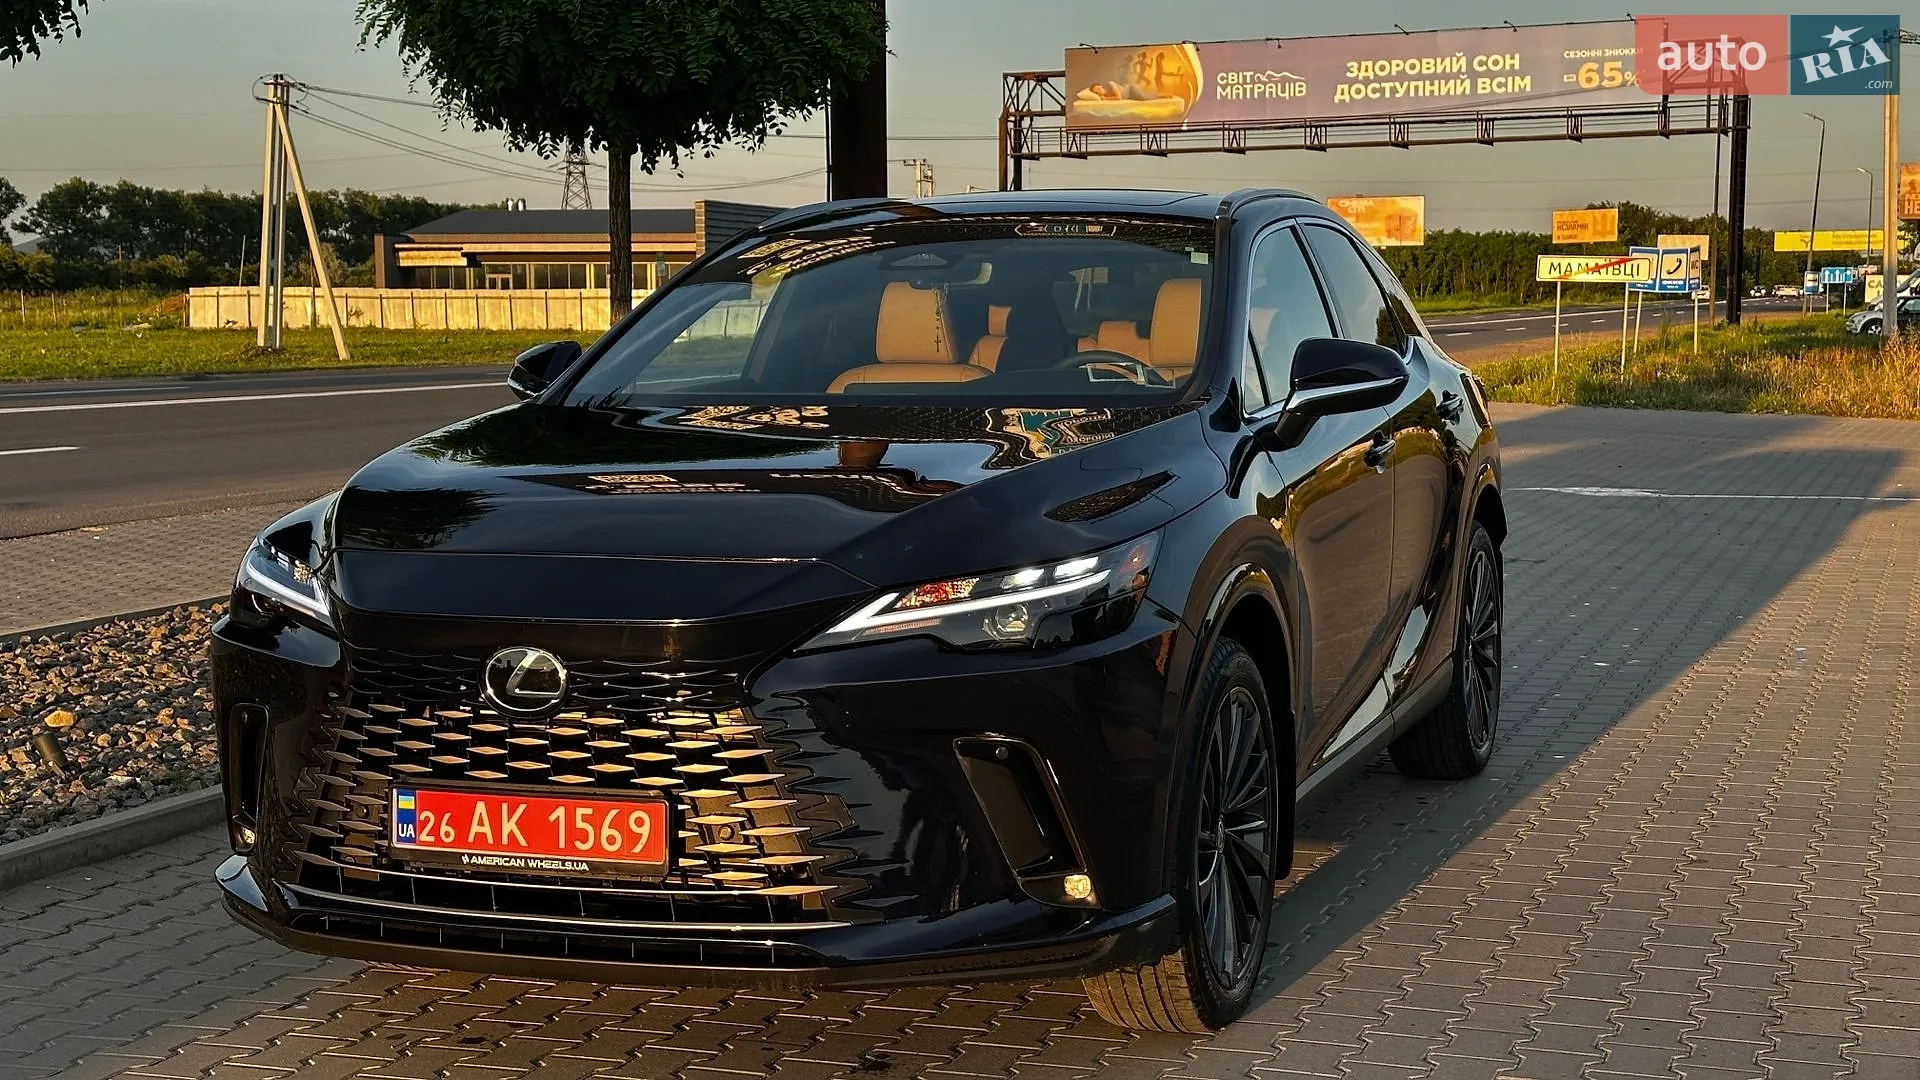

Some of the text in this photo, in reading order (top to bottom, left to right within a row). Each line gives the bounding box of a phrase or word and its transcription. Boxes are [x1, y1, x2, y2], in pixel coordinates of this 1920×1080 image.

[1345, 52, 1520, 80] ЗДОРОВИЙ СОН
[1216, 71, 1254, 84] СВІТ
[1216, 82, 1307, 100] МАТРАЦІВ
[1334, 74, 1532, 103] ДОСТУПНИЙ ВСІМ
[1549, 258, 1640, 278] МАМАЇВЦІ
[398, 823, 415, 838] UA
[419, 800, 651, 854] 26 AK 1569
[470, 855, 589, 871] AMERICAN WHEELS.UA
